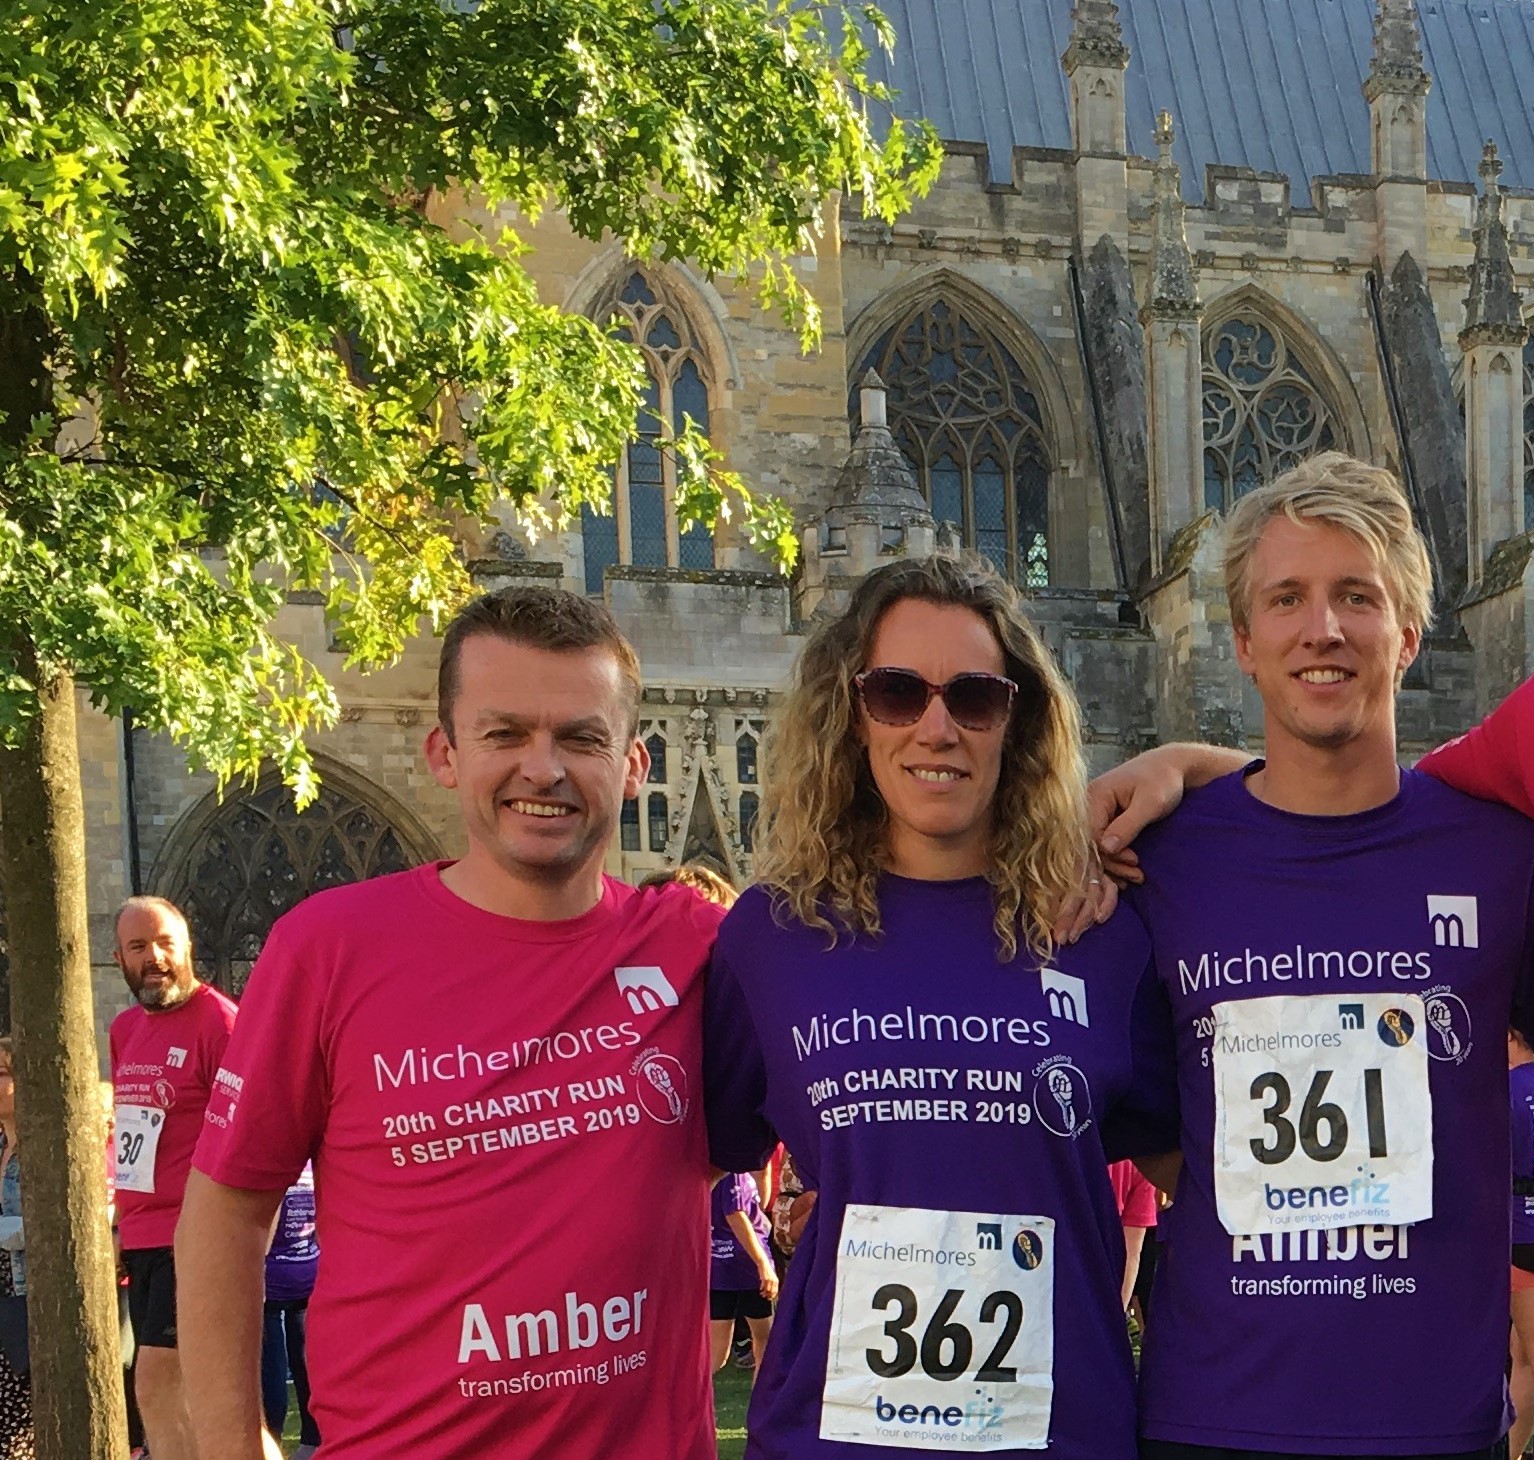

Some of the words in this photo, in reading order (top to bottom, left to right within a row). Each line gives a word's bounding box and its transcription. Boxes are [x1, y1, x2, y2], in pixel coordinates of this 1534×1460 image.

[1177, 944, 1432, 996] Michelmores
[792, 1005, 1051, 1062] Michelmores
[1192, 1016, 1216, 1040] 20
[1222, 1031, 1342, 1054] Michelmores
[372, 1020, 642, 1092] Michelmores
[1201, 1047, 1209, 1068] 5
[382, 1111, 436, 1139] 20th
[444, 1086, 560, 1127] CHARITY
[567, 1074, 626, 1104] RUN
[806, 1078, 840, 1107] 20th
[844, 1068, 959, 1092] CHARITY
[966, 1069, 1022, 1093] RUN
[820, 1099, 968, 1131] SEPTEMBER
[975, 1101, 1031, 1125] 2019
[1249, 1068, 1388, 1165] 361
[391, 1146, 406, 1167] 5
[410, 1115, 580, 1165] SEPTEMBER
[583, 1103, 641, 1133] 2019
[1264, 1175, 1391, 1210] benefiz
[1268, 1213, 1291, 1225] Your
[1294, 1210, 1346, 1223] employee
[1349, 1207, 1391, 1219] benefits
[846, 1239, 977, 1267] Michelmores
[1230, 1274, 1367, 1299] transforming
[1372, 1273, 1417, 1295] lives
[457, 1288, 648, 1364] Amber
[865, 1283, 1024, 1383] 362
[457, 1360, 610, 1398] transforming
[613, 1350, 647, 1376] lives
[876, 1390, 1003, 1430] benefiz
[874, 1425, 899, 1438] Your
[903, 1428, 958, 1442] employee
[961, 1431, 1003, 1442] benefits
